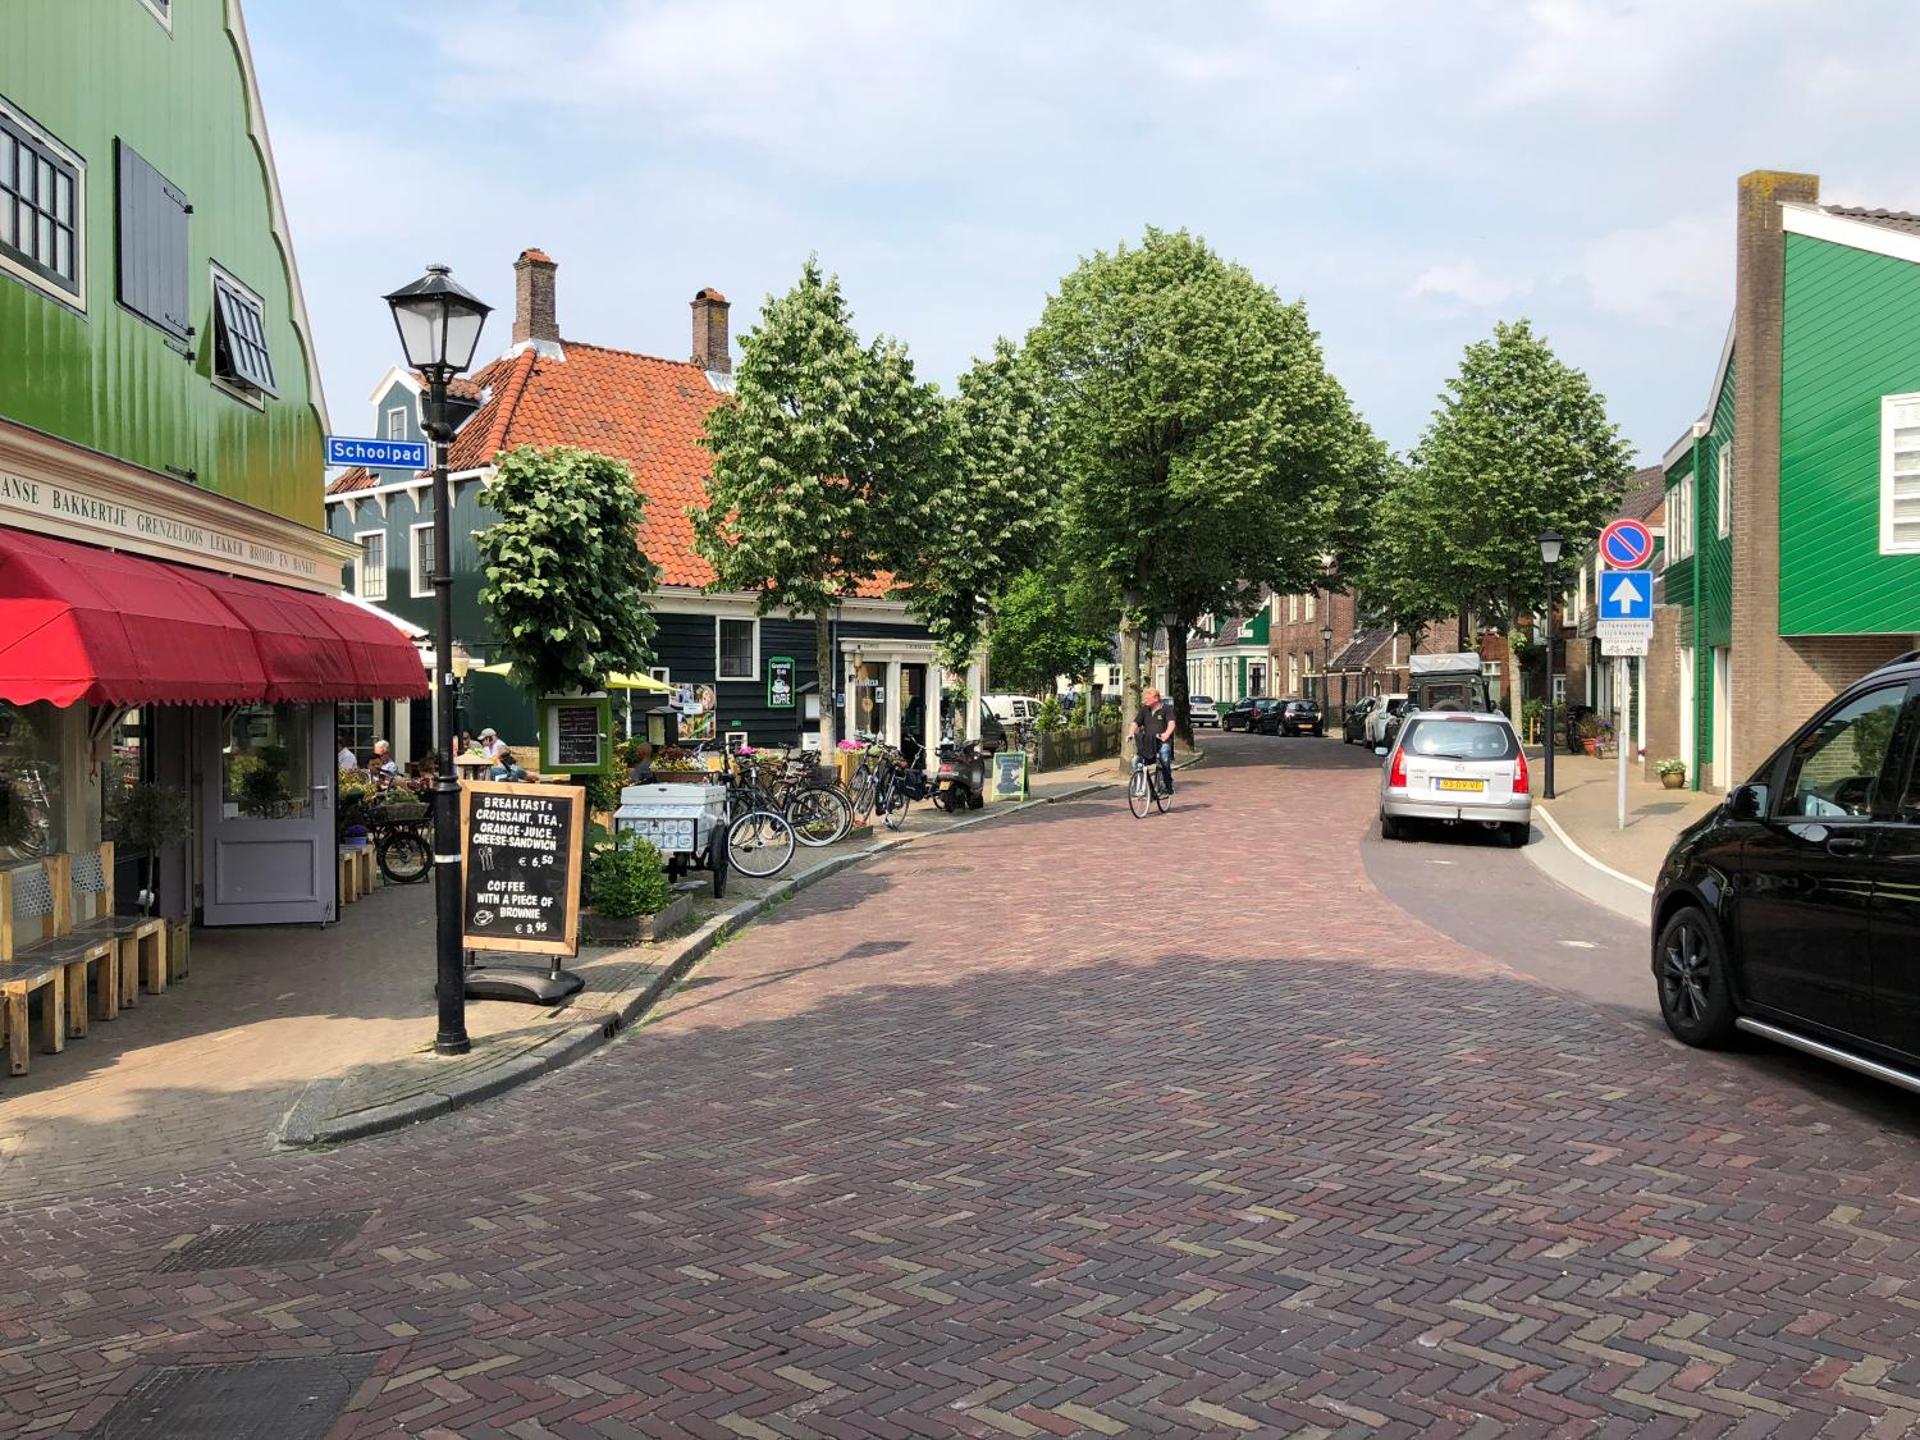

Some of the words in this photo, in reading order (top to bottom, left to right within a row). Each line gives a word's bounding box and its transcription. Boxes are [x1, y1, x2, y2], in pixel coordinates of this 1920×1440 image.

[334, 442, 421, 462] Schoolpad
[53, 490, 127, 527] BAKKERTJE
[137, 513, 203, 546] GRENZELOOS
[210, 536, 243, 556] LEKKER
[249, 545, 274, 564] BROOD
[279, 553, 289, 568] EN
[487, 880, 525, 891] COFFEE
[477, 893, 499, 904] WITH
[503, 894, 509, 904] A
[512, 894, 538, 905] PIECE
[541, 896, 553, 907] OF
[500, 907, 540, 919] BROWNIE
